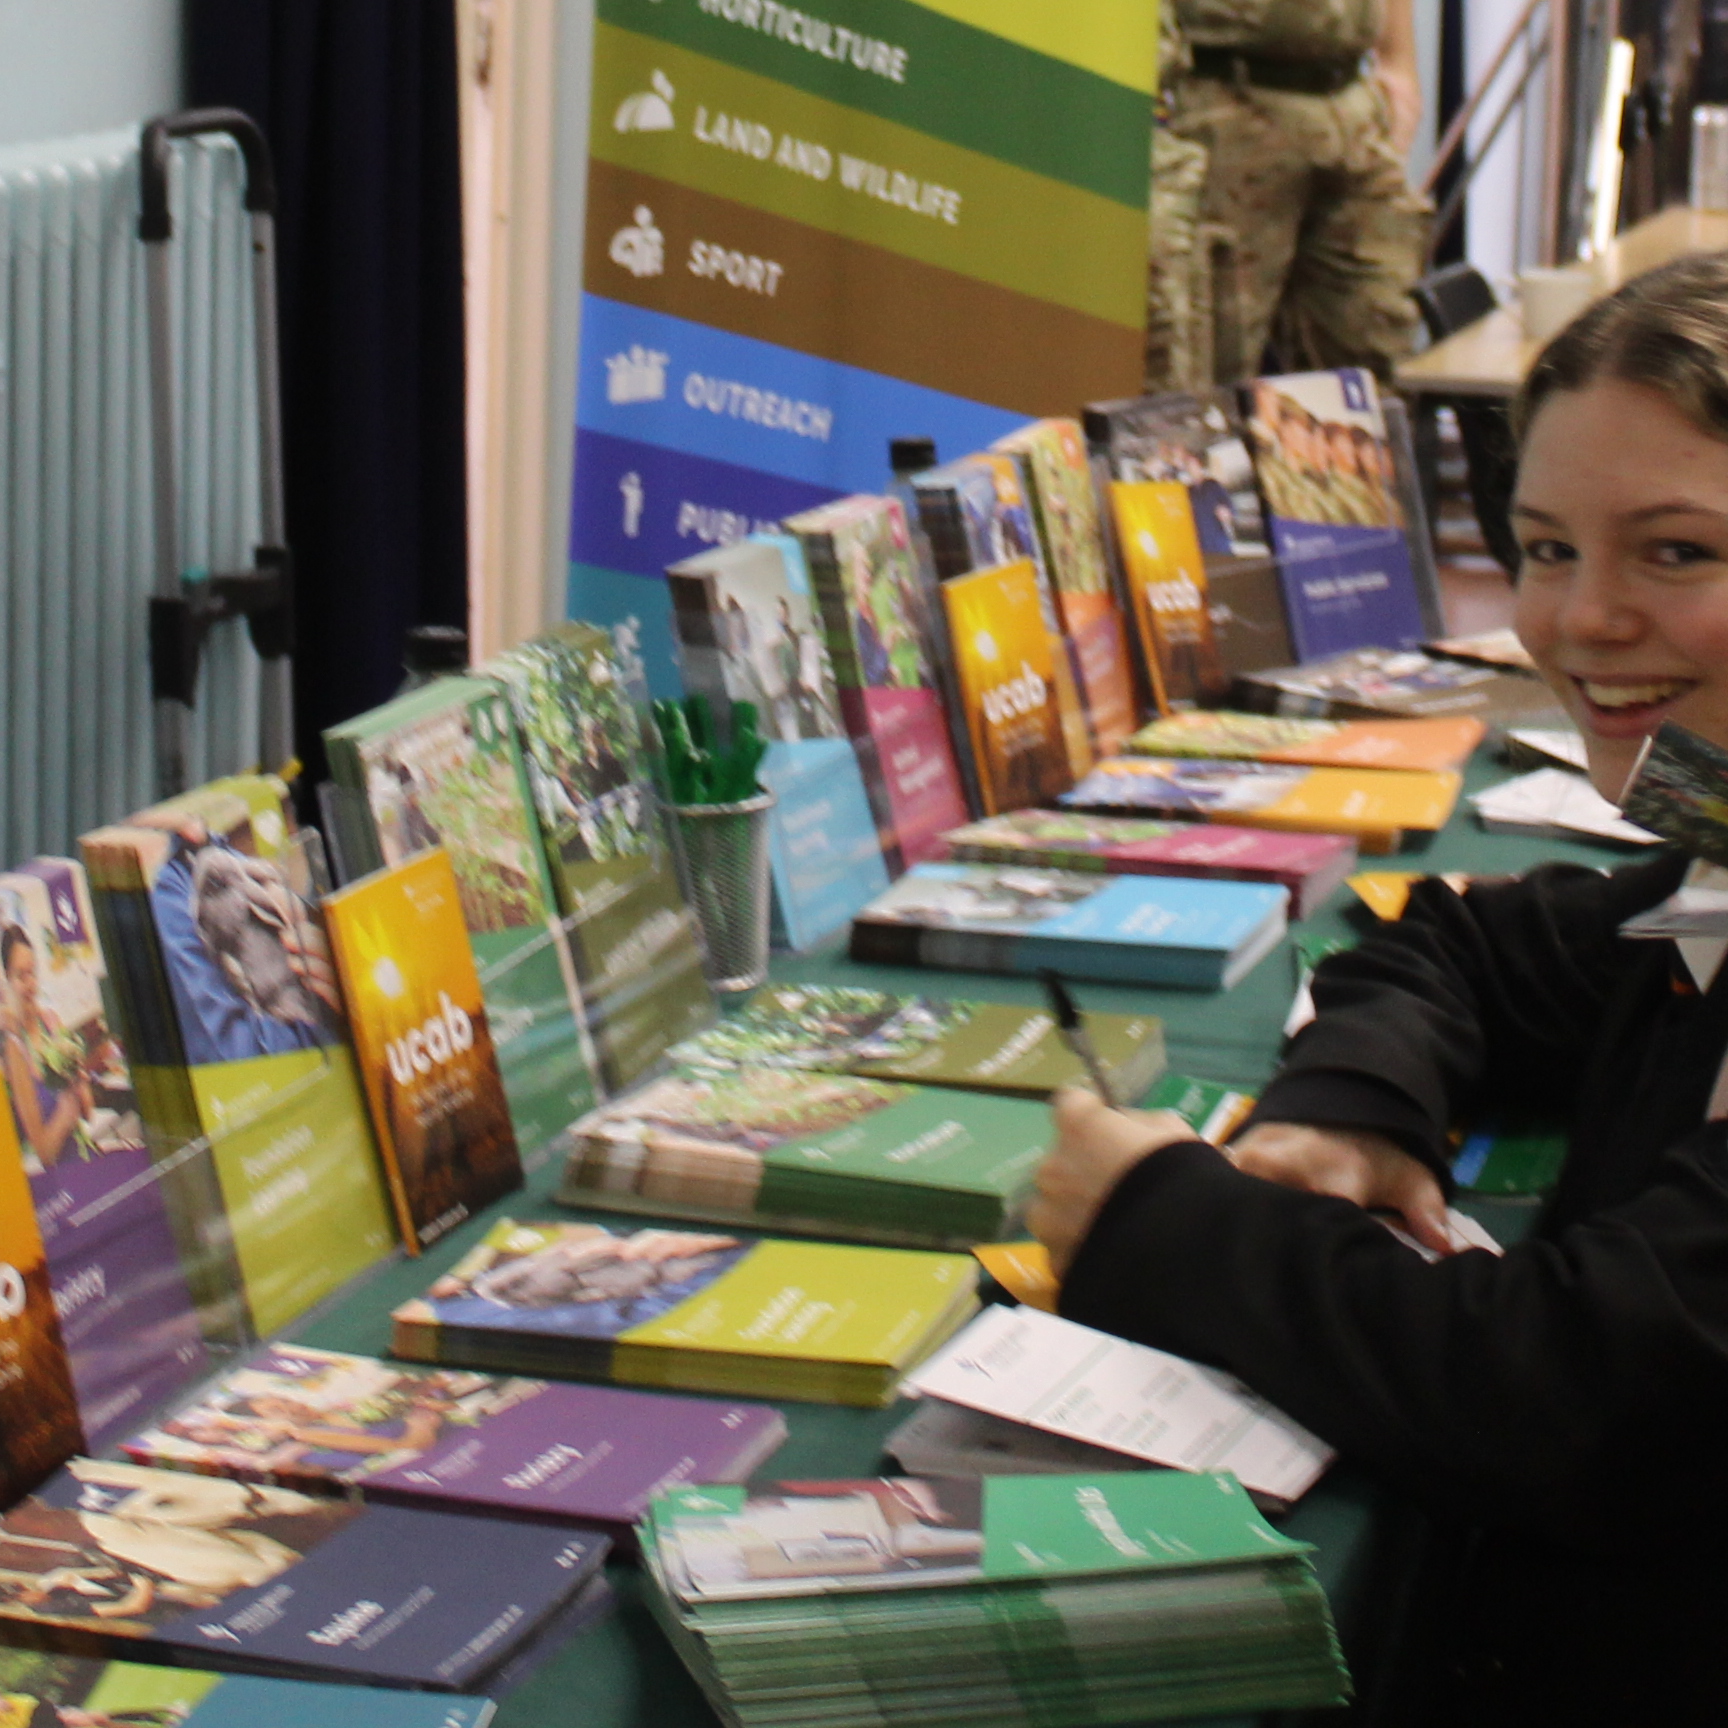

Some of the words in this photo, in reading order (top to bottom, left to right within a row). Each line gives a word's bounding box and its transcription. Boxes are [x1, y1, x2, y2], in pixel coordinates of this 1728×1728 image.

[693, 106, 772, 161] LAND
[775, 135, 833, 182] AND
[838, 151, 963, 227] WILDLIFE
[688, 237, 785, 297] SPORT
[682, 371, 833, 442] OUTREACH
[980, 659, 1048, 725] ucab
[384, 990, 475, 1088] ucab
